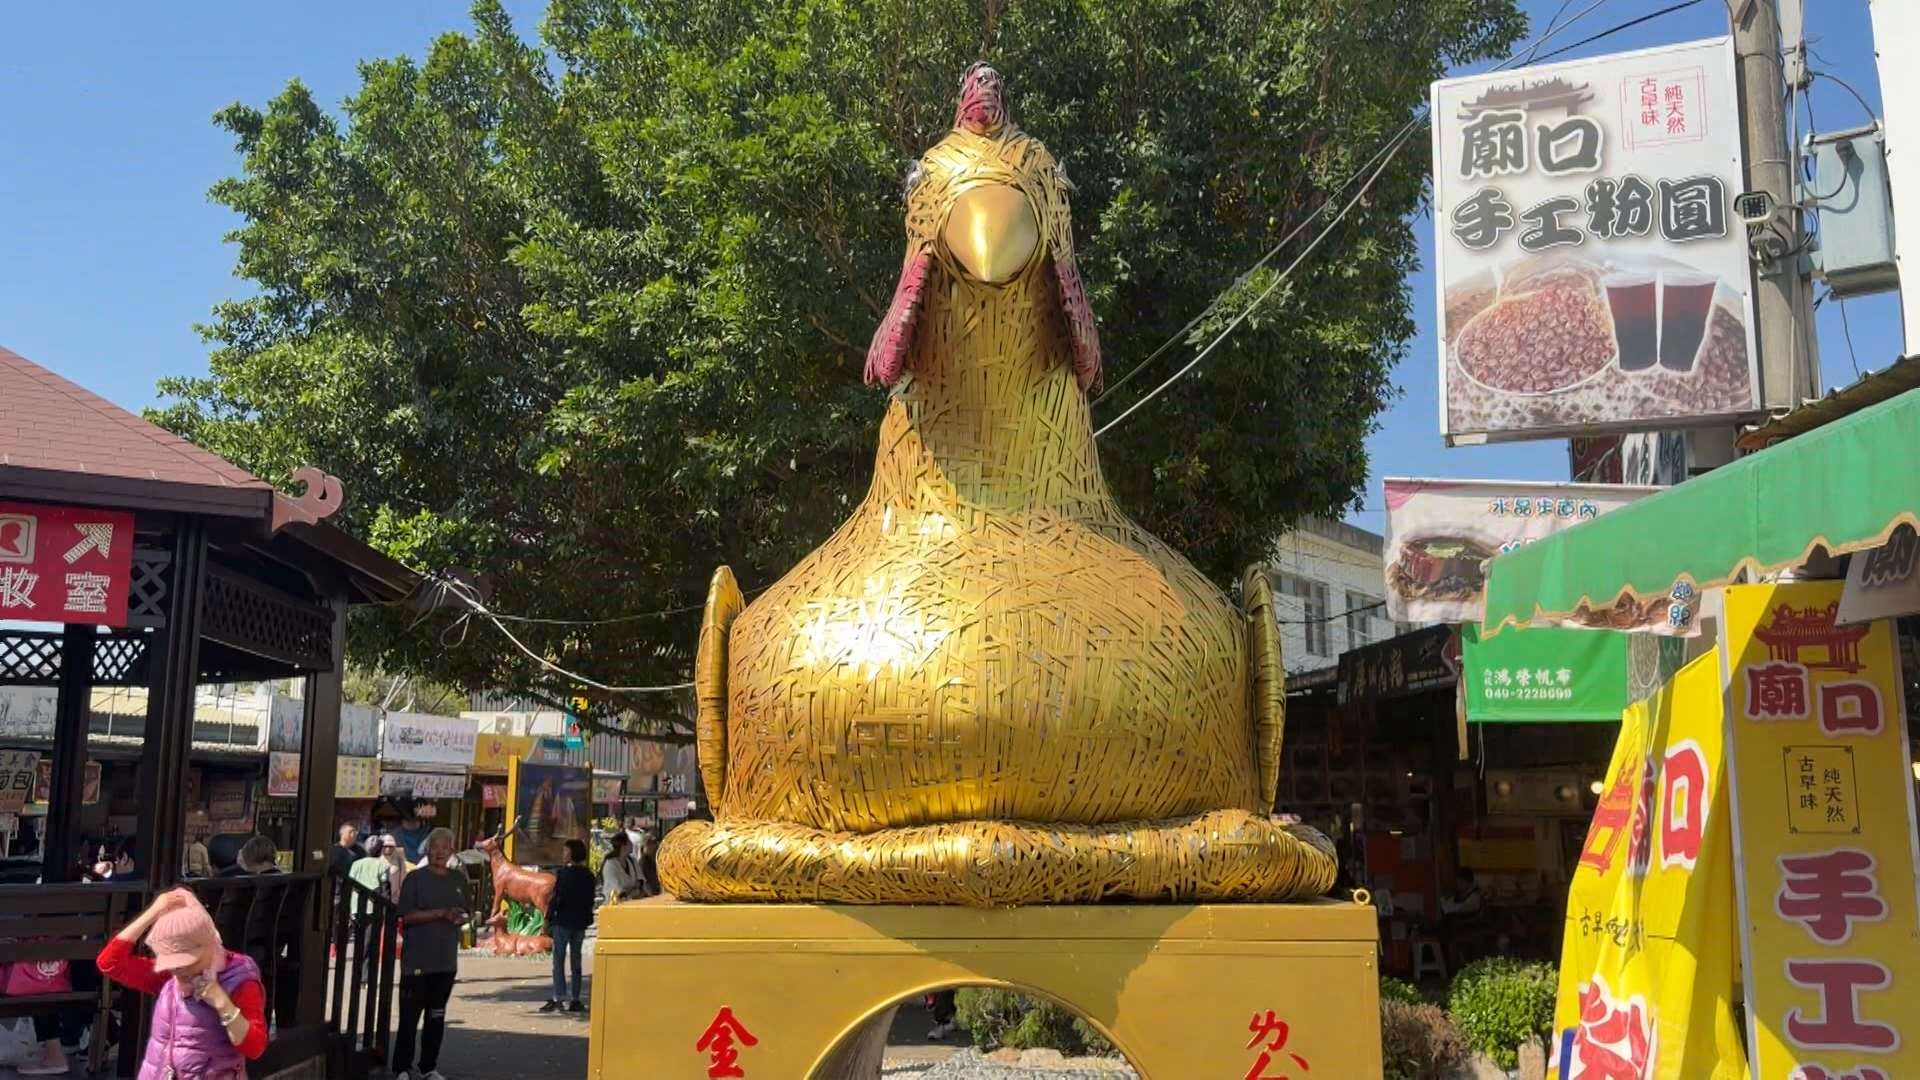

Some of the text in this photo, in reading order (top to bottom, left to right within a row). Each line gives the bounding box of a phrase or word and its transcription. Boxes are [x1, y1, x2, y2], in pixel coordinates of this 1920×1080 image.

[1640, 78, 1659, 125] 古早味
[1664, 85, 1685, 134] 純天然
[1459, 109, 1602, 177] 廟口
[1450, 174, 1728, 250] 手工粉圓
[1744, 661, 1884, 734] 廟口
[1798, 755, 1818, 810] 古早味
[1823, 767, 1846, 823] 純天然
[1777, 849, 1897, 1080] 手工
[695, 1005, 760, 1080] 金
